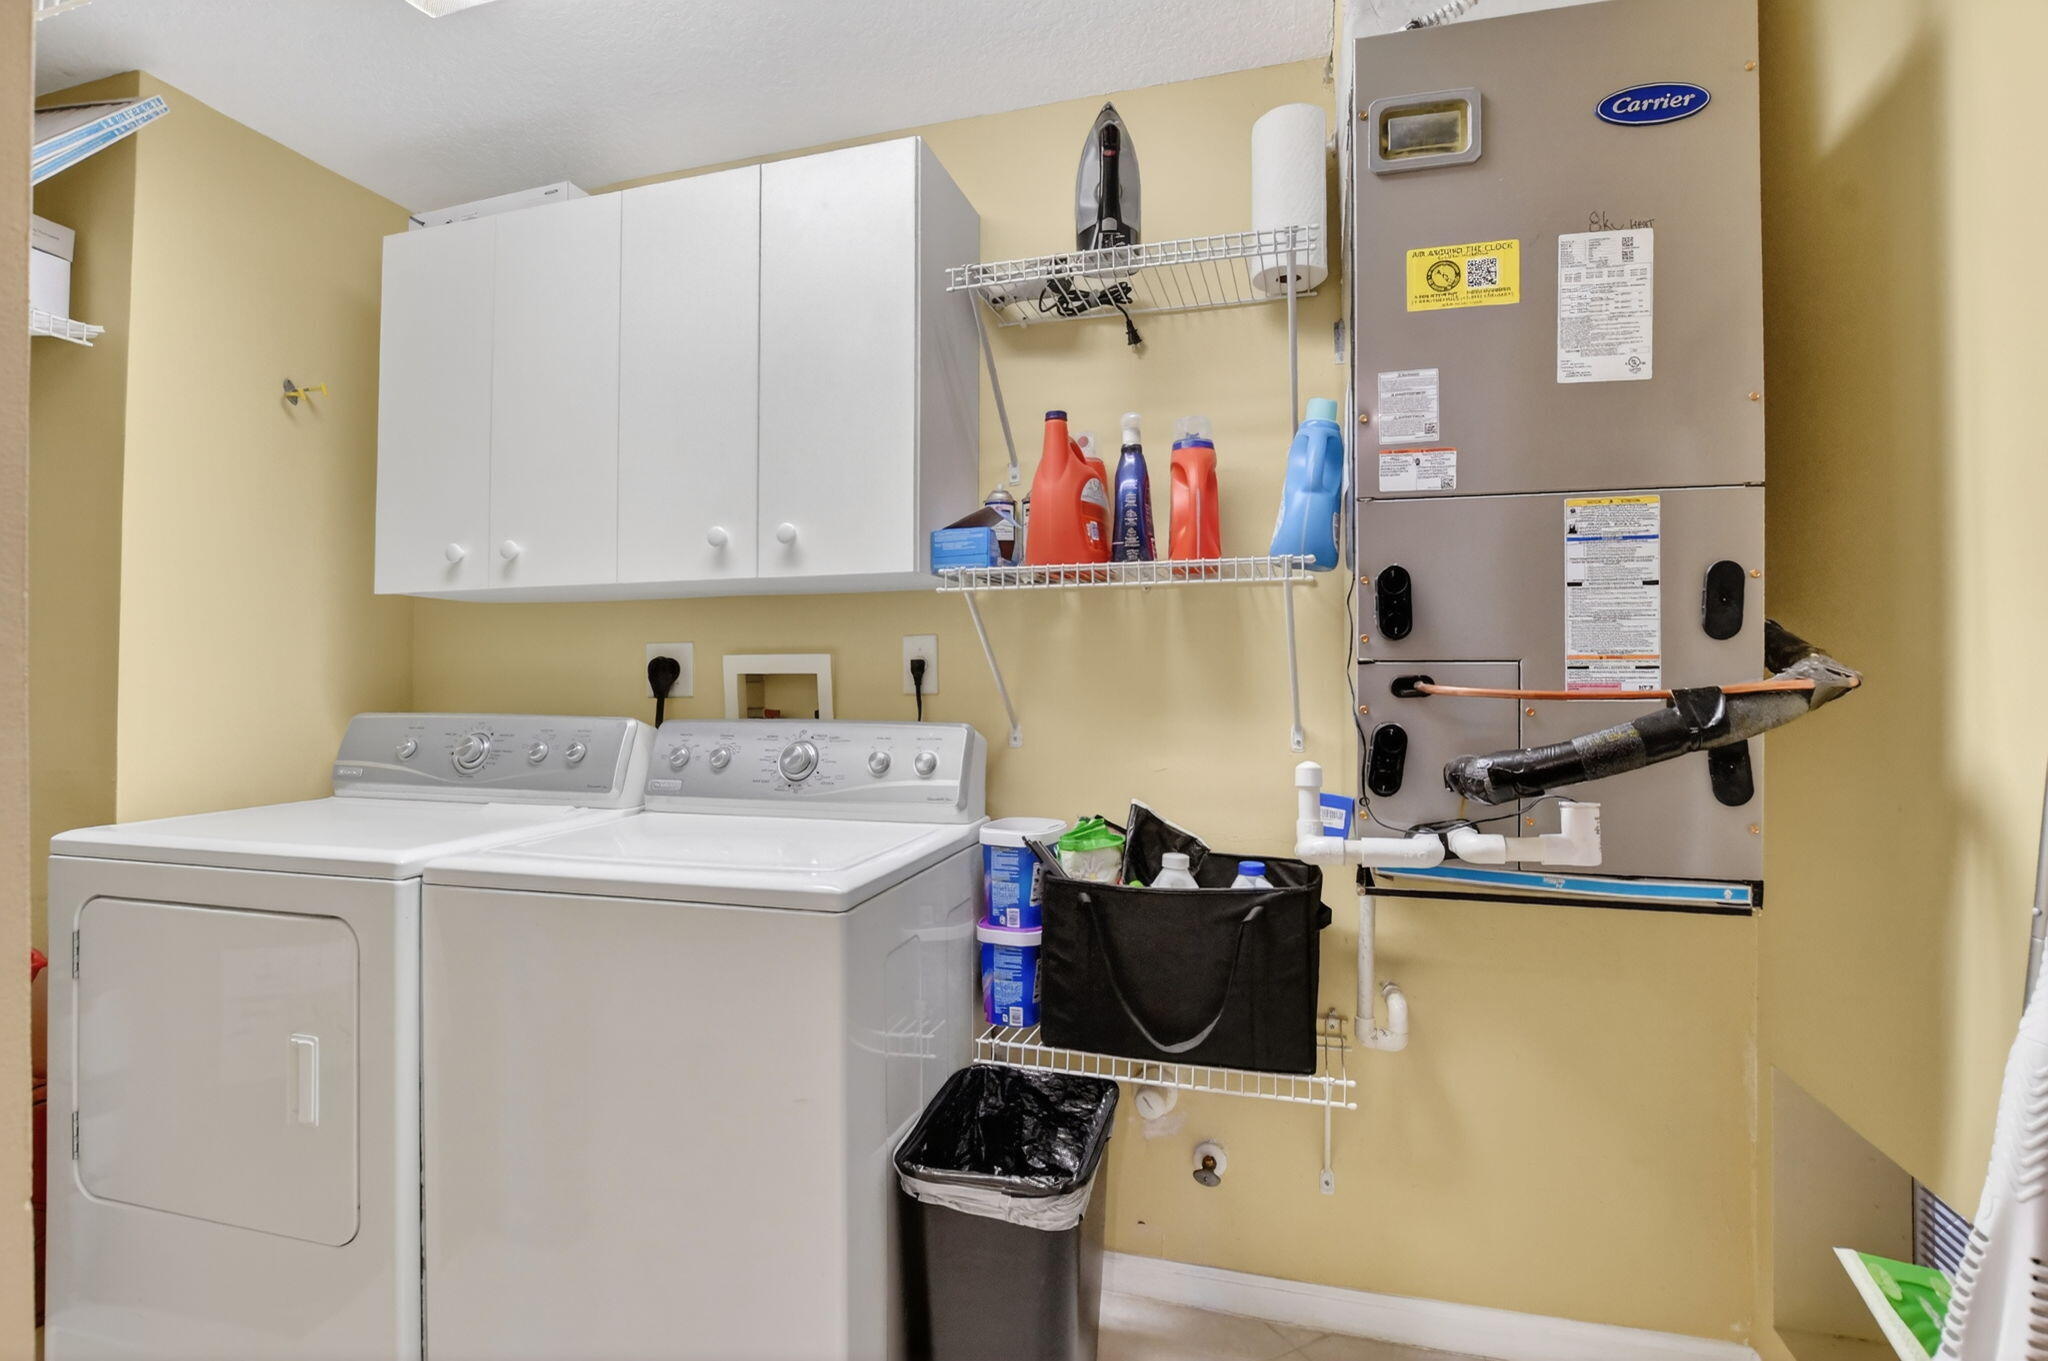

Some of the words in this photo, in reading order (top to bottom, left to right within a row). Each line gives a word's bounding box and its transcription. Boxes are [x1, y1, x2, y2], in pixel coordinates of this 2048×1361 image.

[1612, 93, 1696, 114] Carrier
[1411, 250, 1426, 259] AIR
[1466, 244, 1482, 254] THE
[1484, 241, 1514, 252] CLOCK
